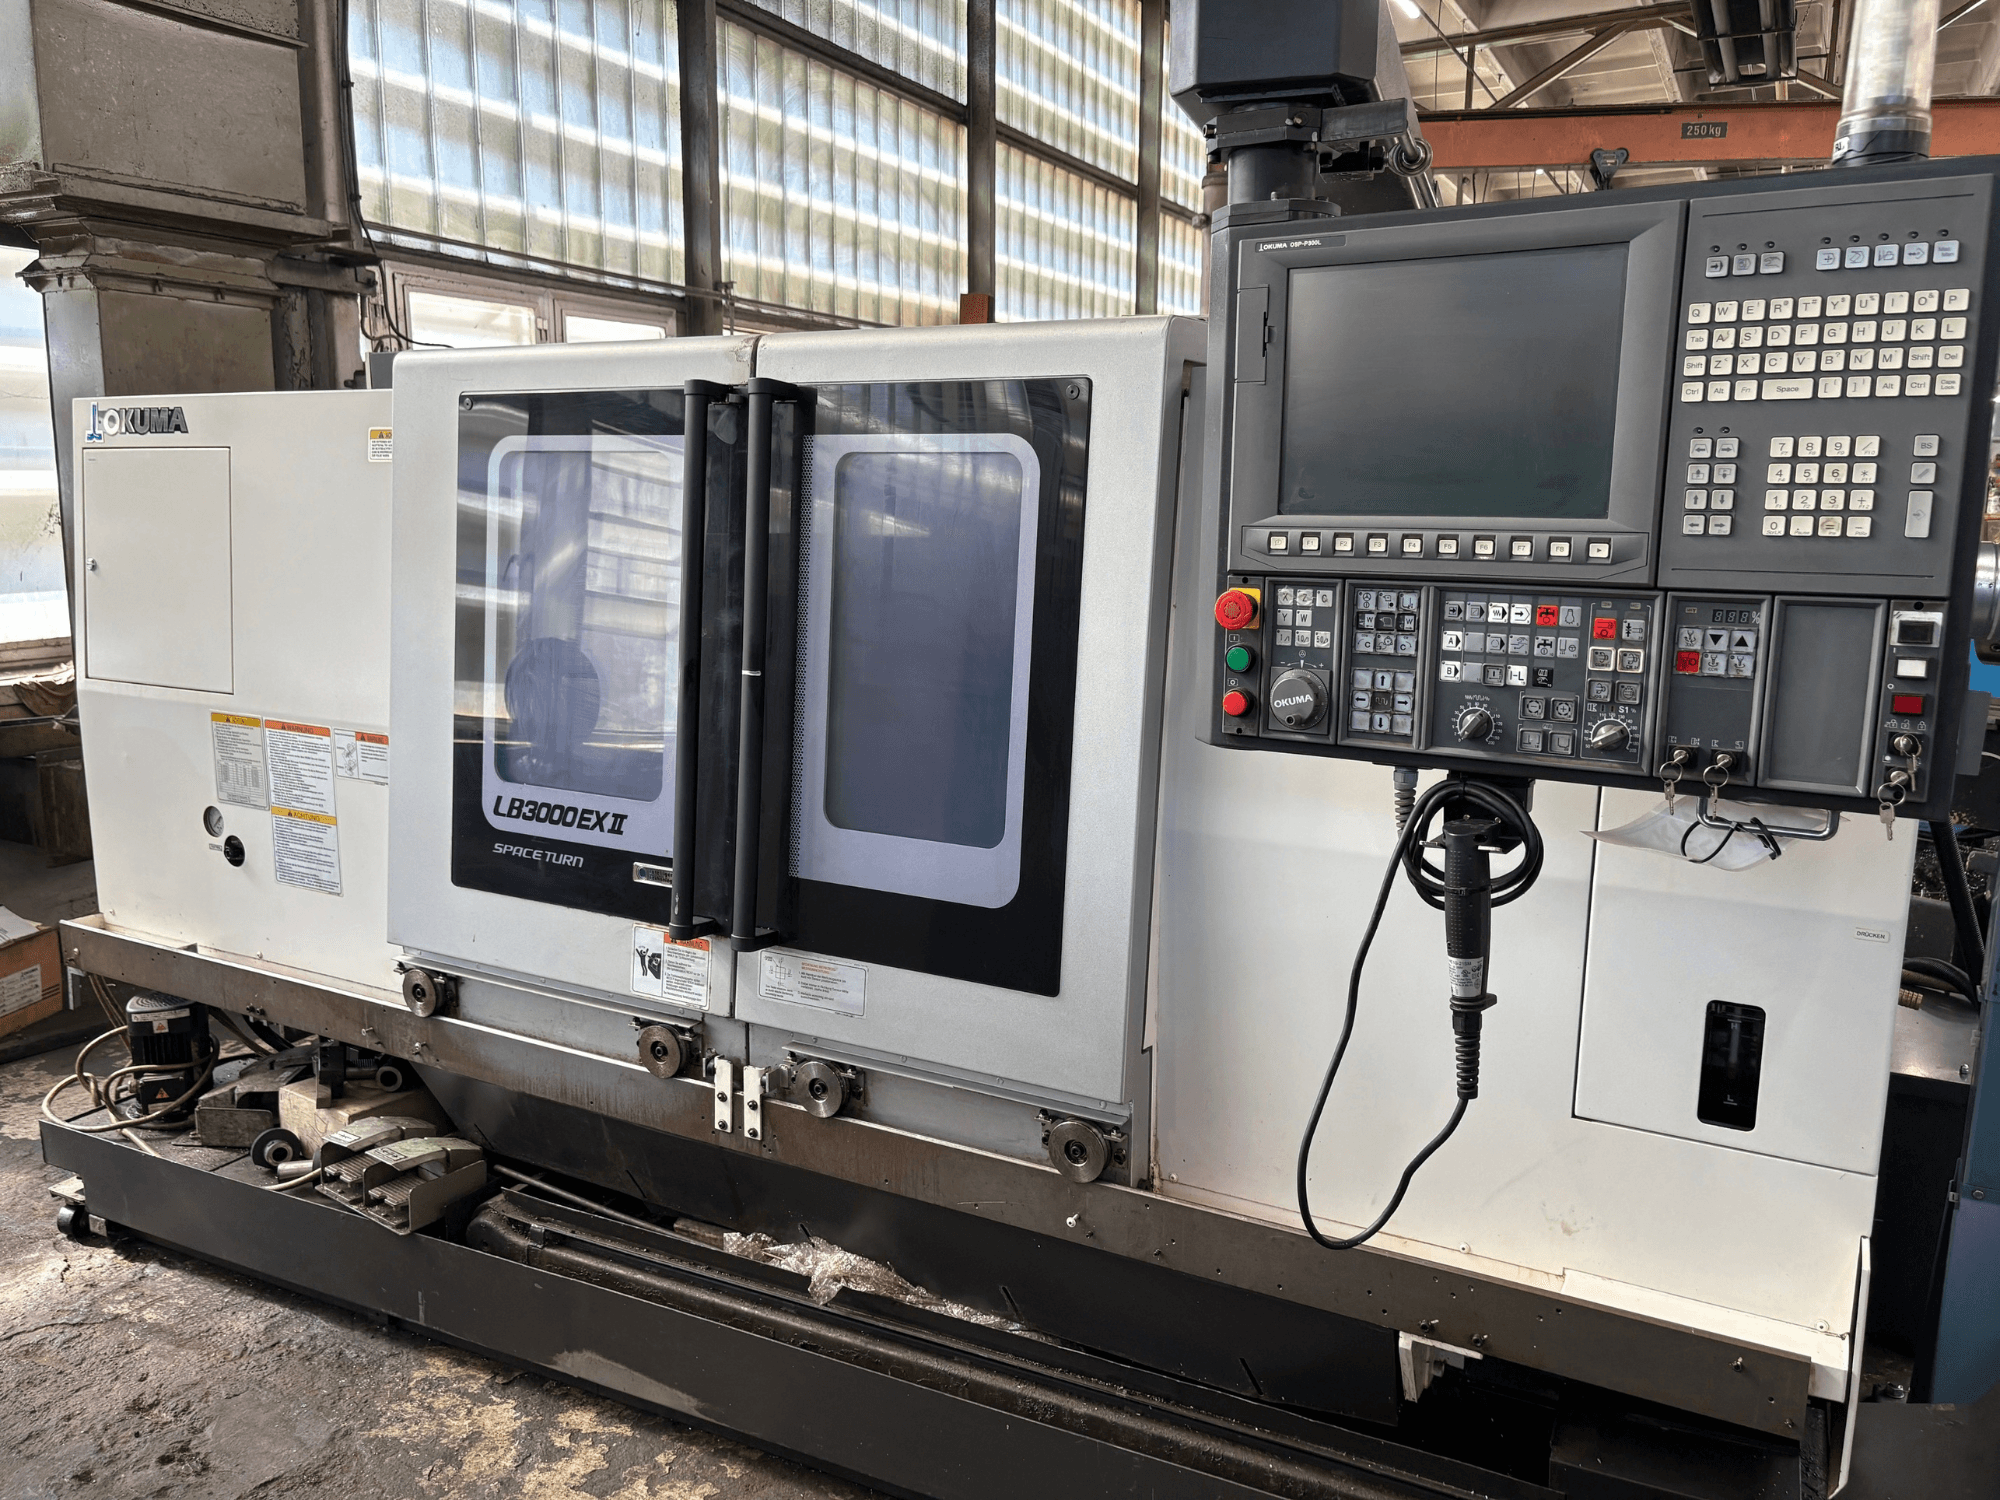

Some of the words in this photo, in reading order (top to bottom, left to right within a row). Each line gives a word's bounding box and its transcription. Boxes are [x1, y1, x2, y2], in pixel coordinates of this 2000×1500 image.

[1687, 125, 1707, 136] 250
[1709, 124, 1721, 137] kg
[1263, 242, 1288, 250] OKUMA
[1859, 299, 1868, 308] U
[1918, 297, 1927, 306] O
[1948, 295, 1957, 304] P
[1774, 304, 1782, 313] R
[1803, 302, 1810, 311] T
[1831, 301, 1839, 309] Y
[1692, 309, 1700, 318] Q
[1718, 307, 1729, 315] W
[1747, 306, 1754, 314] E
[1827, 328, 1836, 337] G
[1857, 327, 1865, 336] H
[1886, 326, 1894, 335] J
[1915, 325, 1924, 334] K
[1947, 324, 1954, 332] L
[1716, 334, 1724, 342] A
[1744, 333, 1752, 341] S
[1771, 331, 1780, 340] D
[1800, 330, 1808, 338] F
[1769, 358, 1777, 366] C
[1797, 357, 1806, 365] V
[1825, 356, 1834, 365] B
[1854, 355, 1862, 364] N
[1882, 354, 1892, 362] M
[1741, 359, 1749, 368] X
[103, 406, 189, 436] OKUMA
[1779, 443, 1786, 451] 7
[1806, 442, 1814, 451] 8
[1834, 442, 1842, 451] 9
[1775, 469, 1783, 477] 4
[1803, 469, 1811, 478] 5
[1831, 469, 1840, 478] 6
[1773, 496, 1778, 504] 1
[1800, 496, 1808, 504] 2
[1829, 496, 1837, 504] 3
[1770, 521, 1778, 530] 0
[1283, 593, 1289, 601] X
[1282, 613, 1287, 621] Y
[1301, 614, 1308, 622] W
[1448, 637, 1453, 645] A
[1446, 667, 1452, 675] B
[1274, 693, 1313, 708] OKUMA
[1856, 930, 1886, 939] DRÜCKEN
